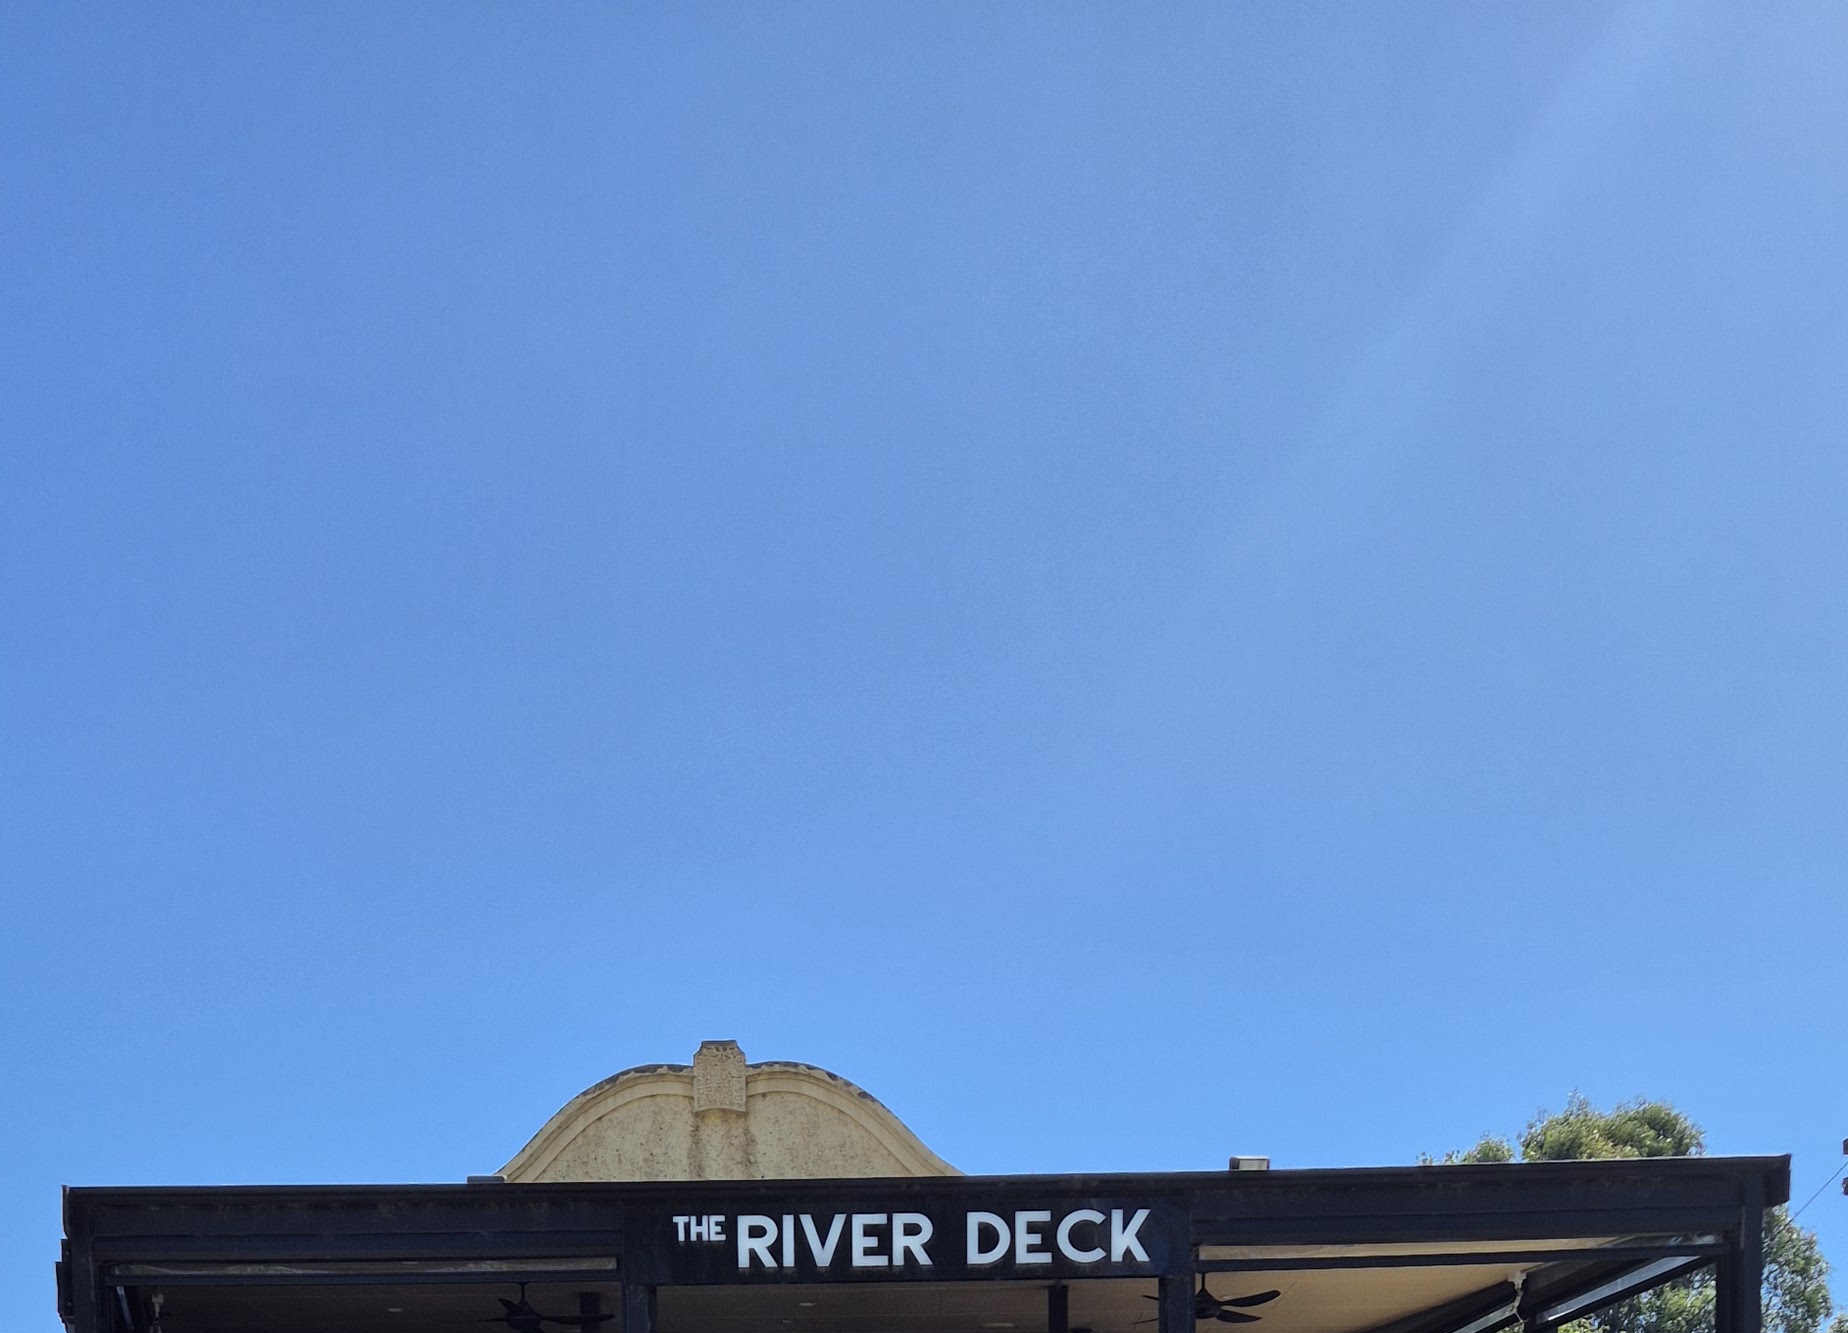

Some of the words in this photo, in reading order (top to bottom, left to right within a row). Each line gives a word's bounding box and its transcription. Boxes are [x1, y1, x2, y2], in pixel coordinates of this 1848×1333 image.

[673, 1214, 727, 1243] THE
[736, 1213, 934, 1269] RIVER
[966, 1207, 1152, 1265] DECK
